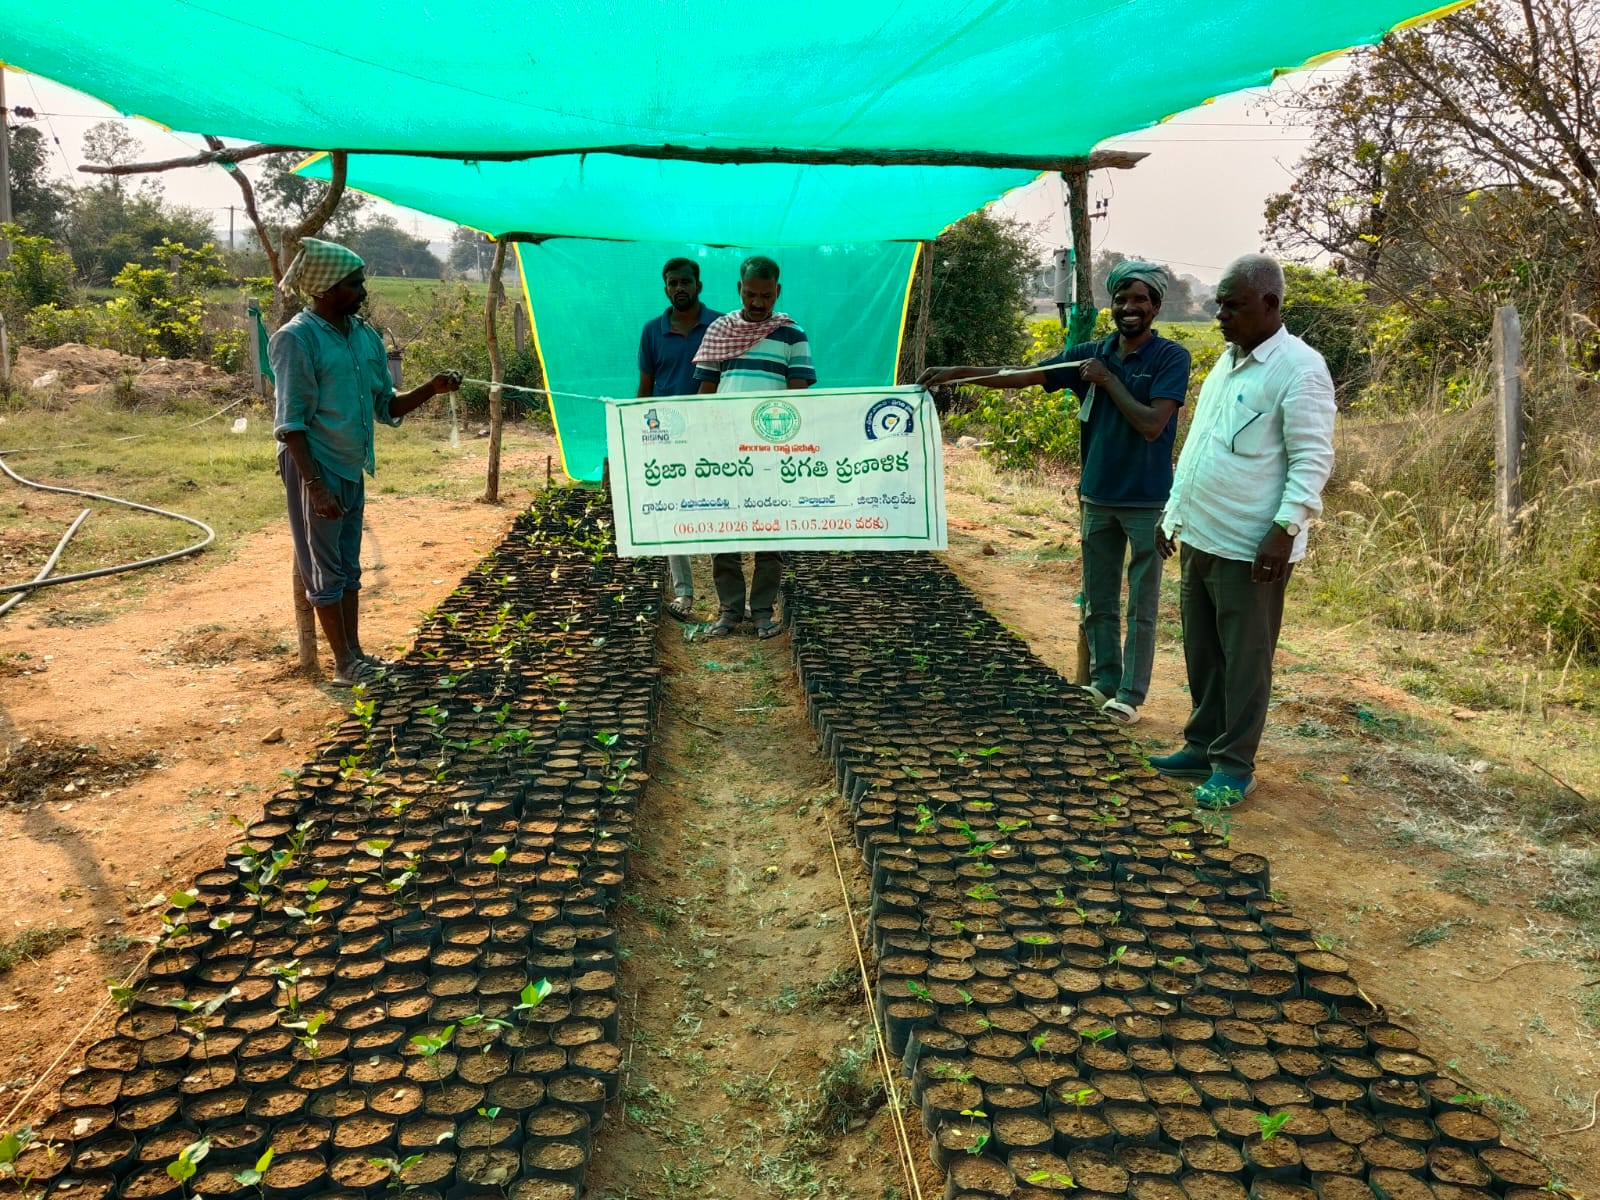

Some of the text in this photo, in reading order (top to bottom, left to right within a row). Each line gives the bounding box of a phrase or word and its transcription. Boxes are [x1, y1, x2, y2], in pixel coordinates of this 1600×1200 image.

[644, 458, 687, 486] ప్రజా
[694, 456, 754, 478] పాలన
[780, 456, 829, 484] ప్రగతి
[836, 450, 910, 484] ప్రణాళిక
[642, 500, 678, 515] గ్రామం:
[673, 517, 889, 537] (06.03.2026 నుండి 15.05.2026 వరకు)
